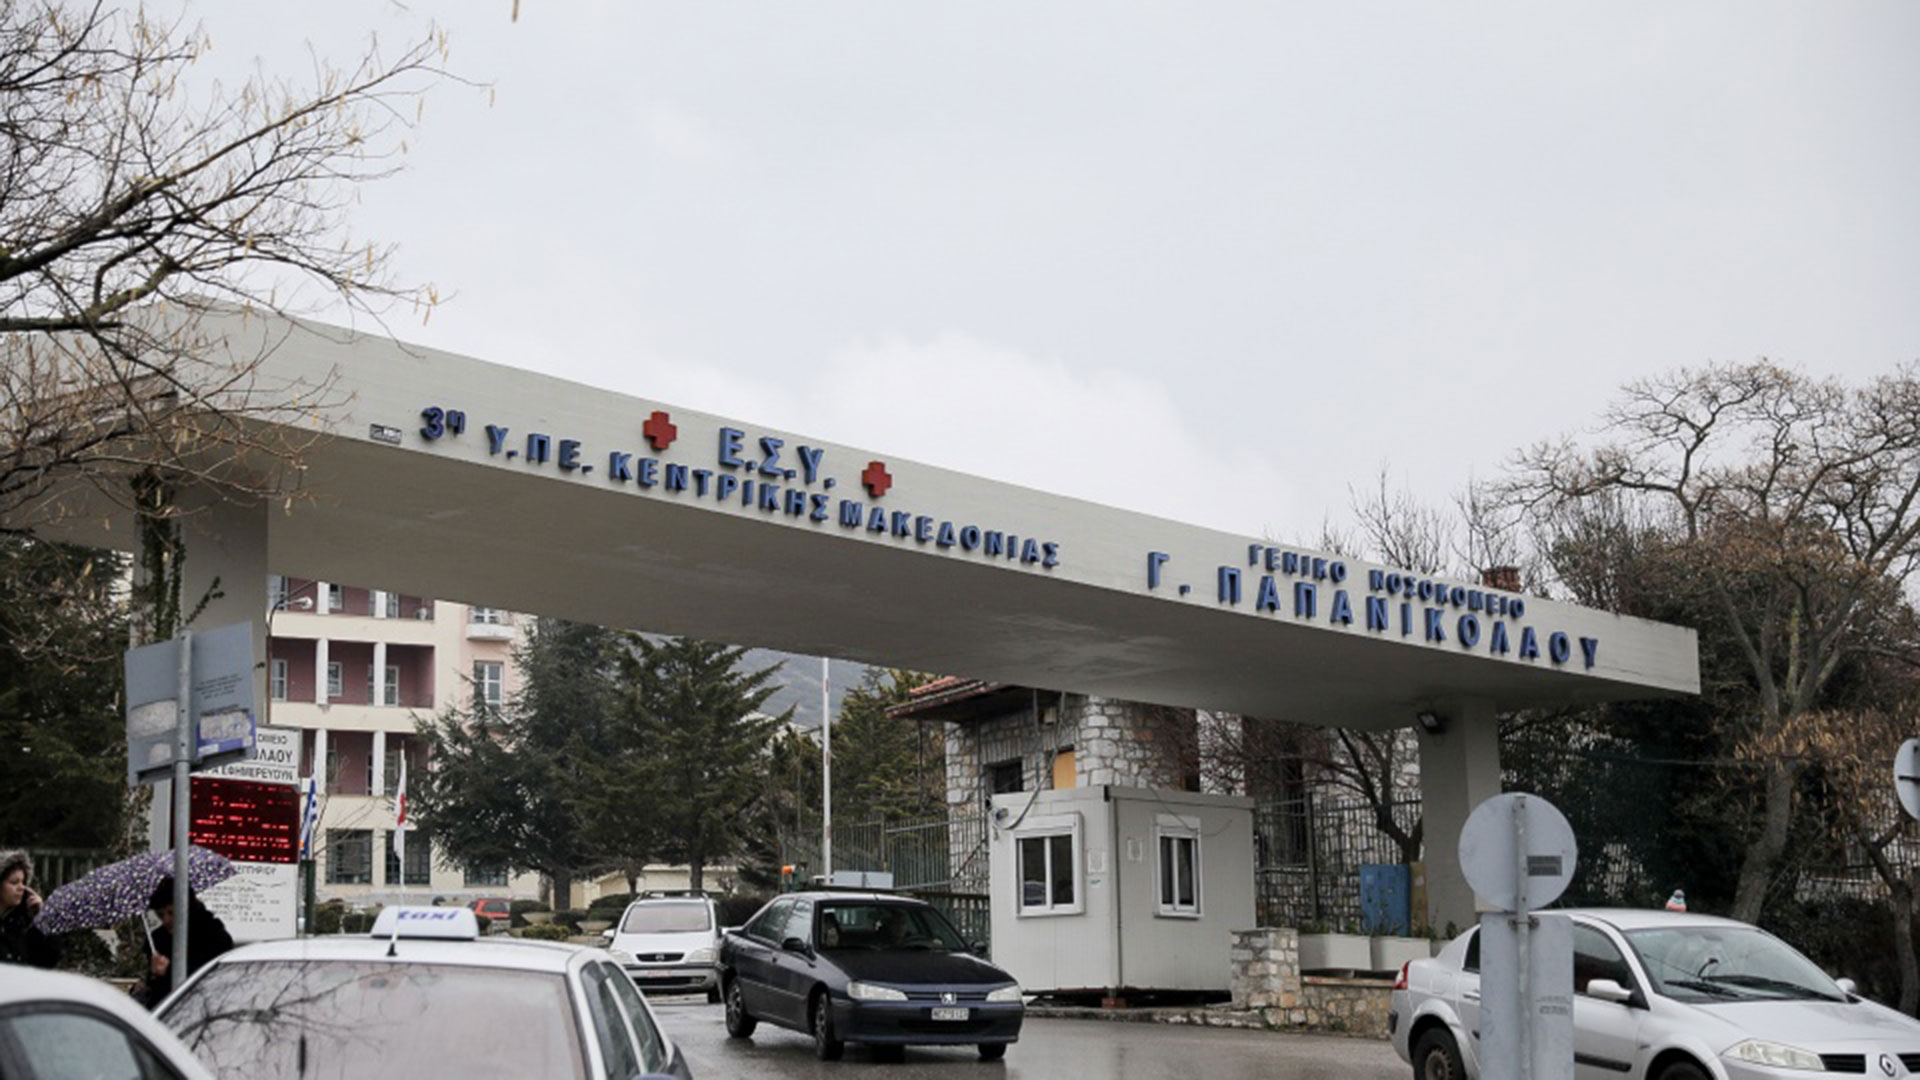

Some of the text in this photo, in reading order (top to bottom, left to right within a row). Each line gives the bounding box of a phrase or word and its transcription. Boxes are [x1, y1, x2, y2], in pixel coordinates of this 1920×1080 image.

[419, 406, 1060, 568] 3η Υ.ΠΕ. ΚΕΝΤΡΙΚΗΣ ΜΑΚΕΔΟΝΙΑΣ
[719, 427, 836, 489] Ε.Σ.Υ.
[1147, 551, 1599, 669] Γ. ΠΑΠΑΝΙΚΟΛΑΟΥ
[1249, 543, 1525, 618] ΓΕΝΙΚΟ ΝΟΣΟΚΟΜΕΙΟ
[398, 910, 459, 920] taxi
